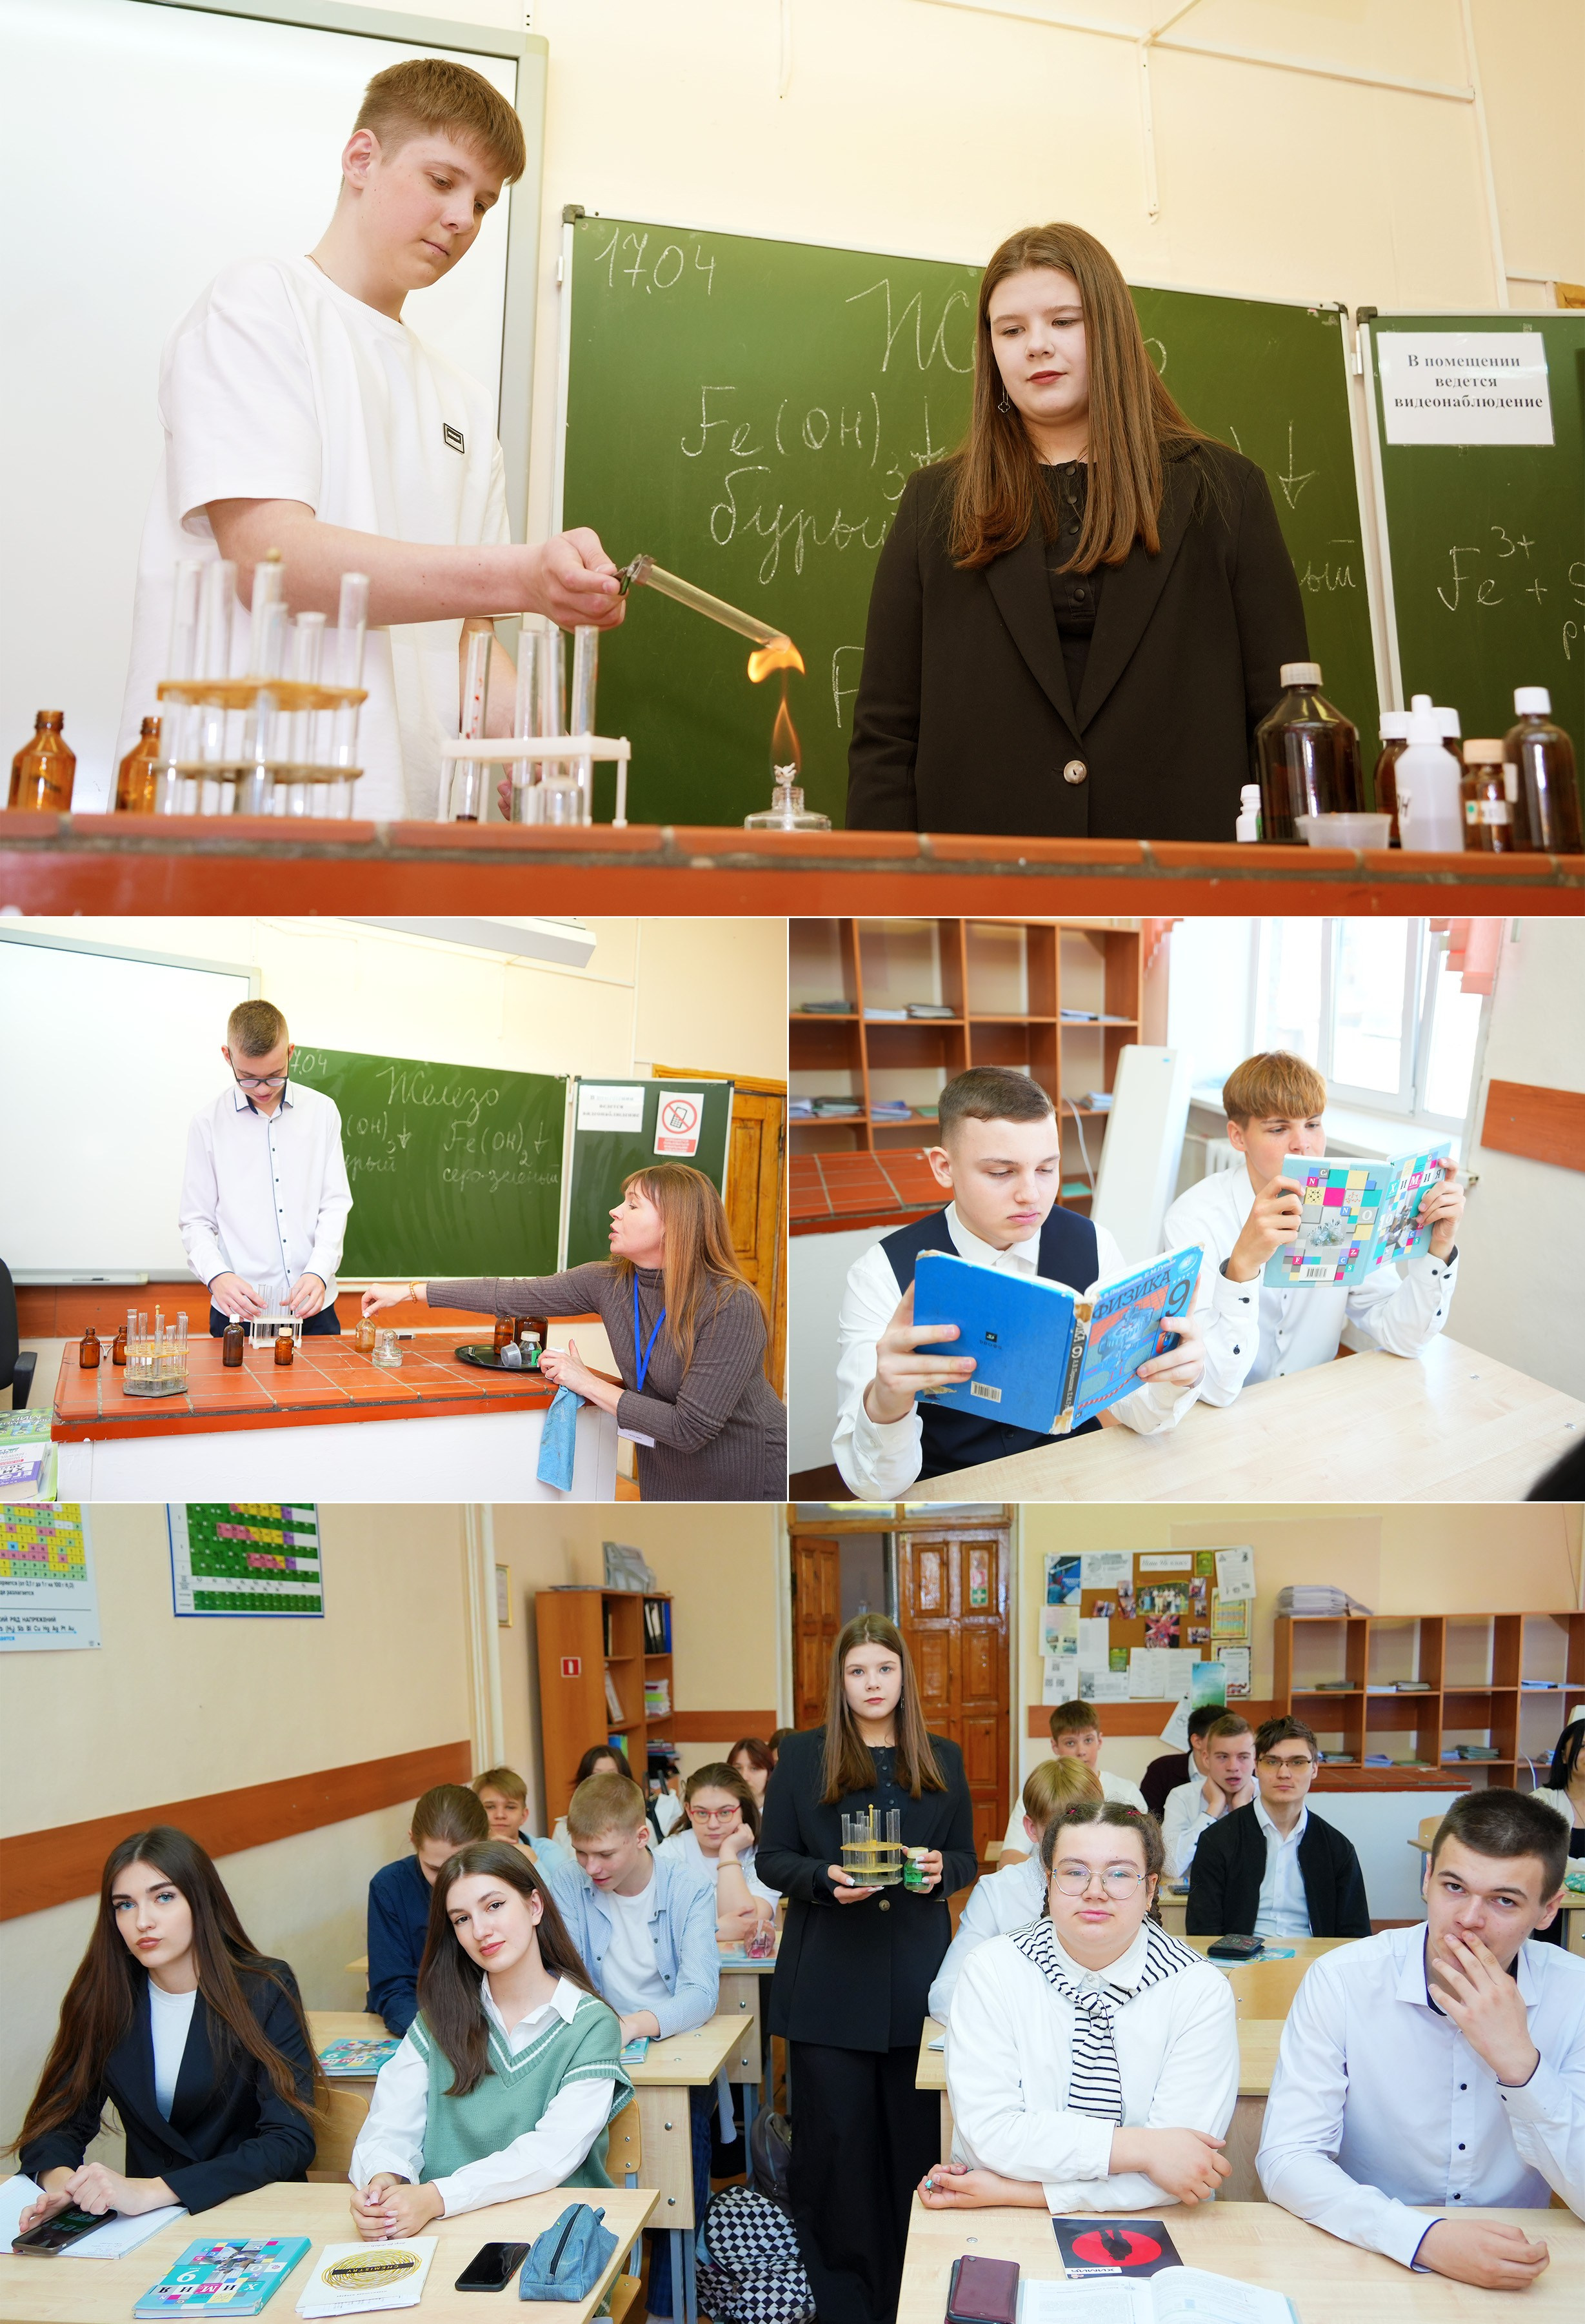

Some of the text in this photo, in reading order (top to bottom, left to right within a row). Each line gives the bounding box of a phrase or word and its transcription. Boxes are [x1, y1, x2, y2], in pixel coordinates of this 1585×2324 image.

[1408, 355, 1521, 369] В помещении
[1435, 376, 1498, 388] ведется
[1395, 394, 1544, 410] видеонаблюдение
[375, 1066, 499, 1127] Железо
[1092, 1269, 1171, 1319] ФИЗИКА
[1165, 1279, 1191, 1317] 9
[176, 2269, 199, 2283] 9
[347, 2265, 399, 2273] CHEMISTRY
[157, 2283, 259, 2294] ХИМИЯ
